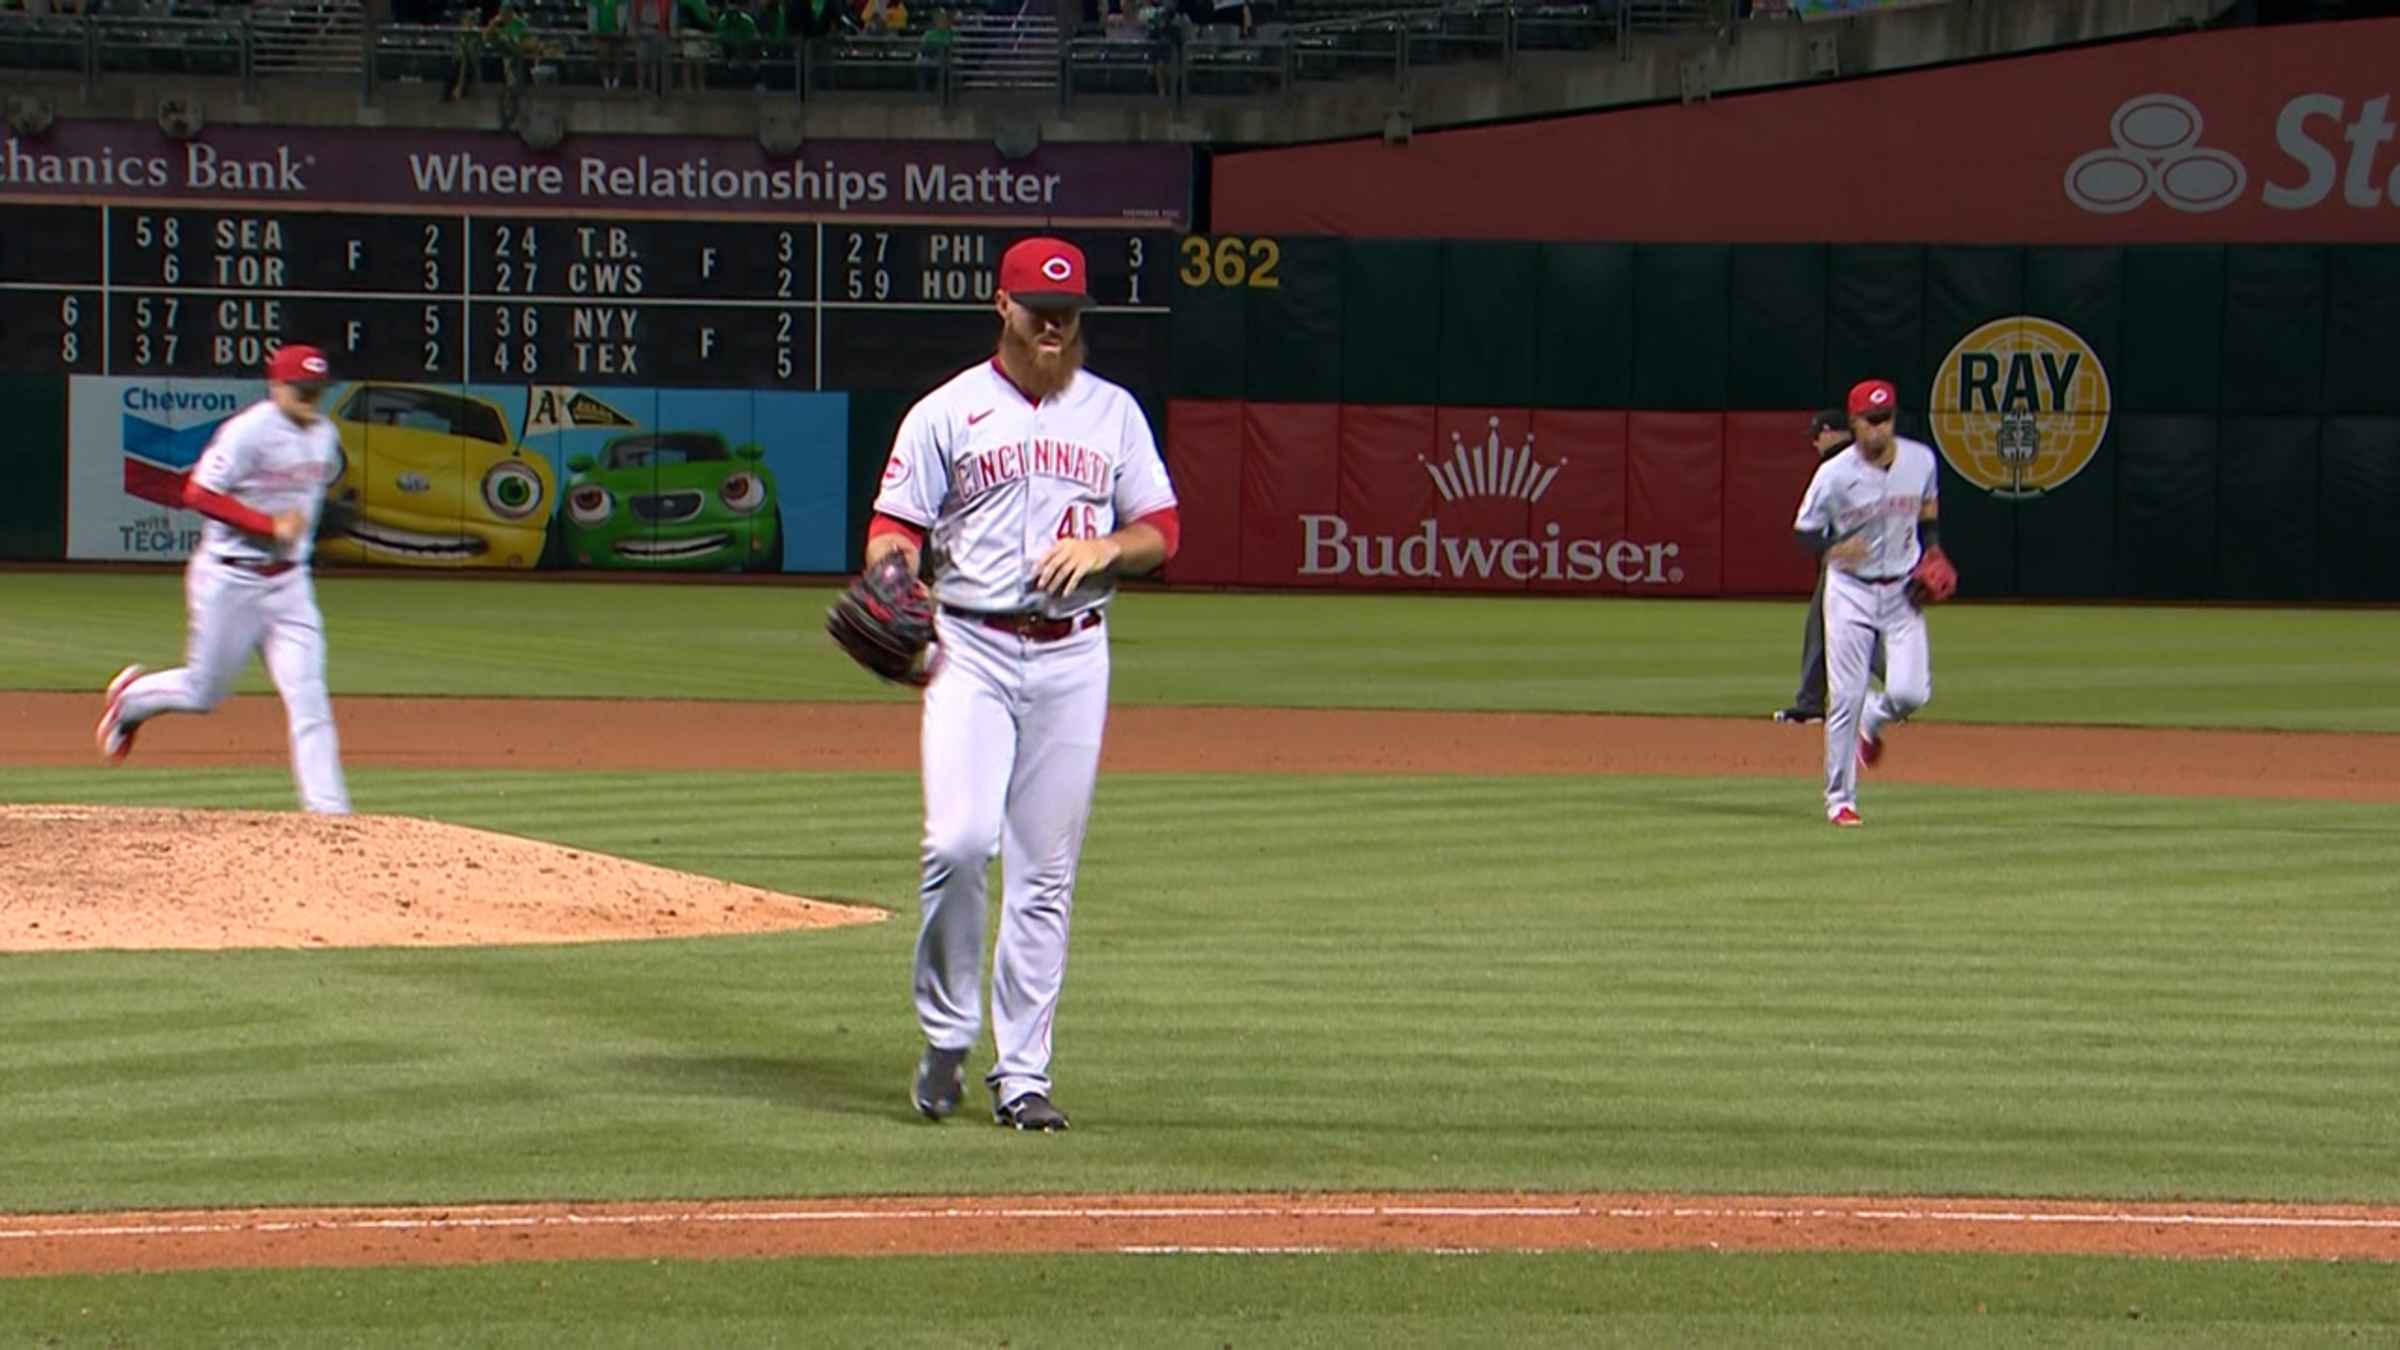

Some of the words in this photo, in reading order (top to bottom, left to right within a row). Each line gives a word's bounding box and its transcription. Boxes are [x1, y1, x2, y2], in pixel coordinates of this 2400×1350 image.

[0, 137, 168, 187] hanics
[186, 142, 306, 191] Bank
[2261, 93, 2400, 209] St
[409, 153, 563, 195] Where
[579, 155, 888, 210] Relationships
[904, 162, 1061, 203] Matter
[135, 216, 180, 248] 58
[215, 218, 283, 250] SEA
[424, 224, 439, 255] 2
[496, 226, 537, 257] 24
[577, 227, 638, 259] T.B.
[777, 231, 793, 262] 3
[848, 232, 889, 263] 27
[930, 234, 984, 264] PHI
[1128, 237, 1144, 268] 3
[163, 253, 180, 284] 6
[214, 255, 285, 287] TOR
[424, 259, 439, 291] 3
[347, 240, 362, 271] F
[701, 248, 716, 279] F
[1179, 235, 1280, 288] 362
[496, 263, 537, 293] 27
[568, 263, 643, 294] CWS
[777, 267, 793, 298] 2
[849, 269, 890, 300] 59
[922, 270, 993, 300] HOU
[1128, 274, 1140, 304] 1
[62, 295, 78, 327] 6
[136, 297, 179, 328] 57
[218, 299, 282, 331] CLE
[424, 304, 439, 335] 5
[496, 306, 538, 337] 36
[573, 307, 638, 338] NYY
[776, 311, 792, 342] 2
[61, 332, 78, 363] 8
[135, 335, 179, 365] 37
[213, 335, 283, 366] BOS
[424, 341, 439, 371] 2
[347, 320, 362, 351] F
[701, 327, 715, 358] F
[494, 343, 538, 374] 48
[574, 343, 638, 373] TEX
[776, 347, 792, 379] 5
[123, 386, 236, 412] Chevron
[1959, 351, 2082, 414] RAY
[955, 437, 1111, 502] CINCINNATI
[1056, 504, 1097, 541] 46
[1298, 514, 1679, 584] Budweiser
